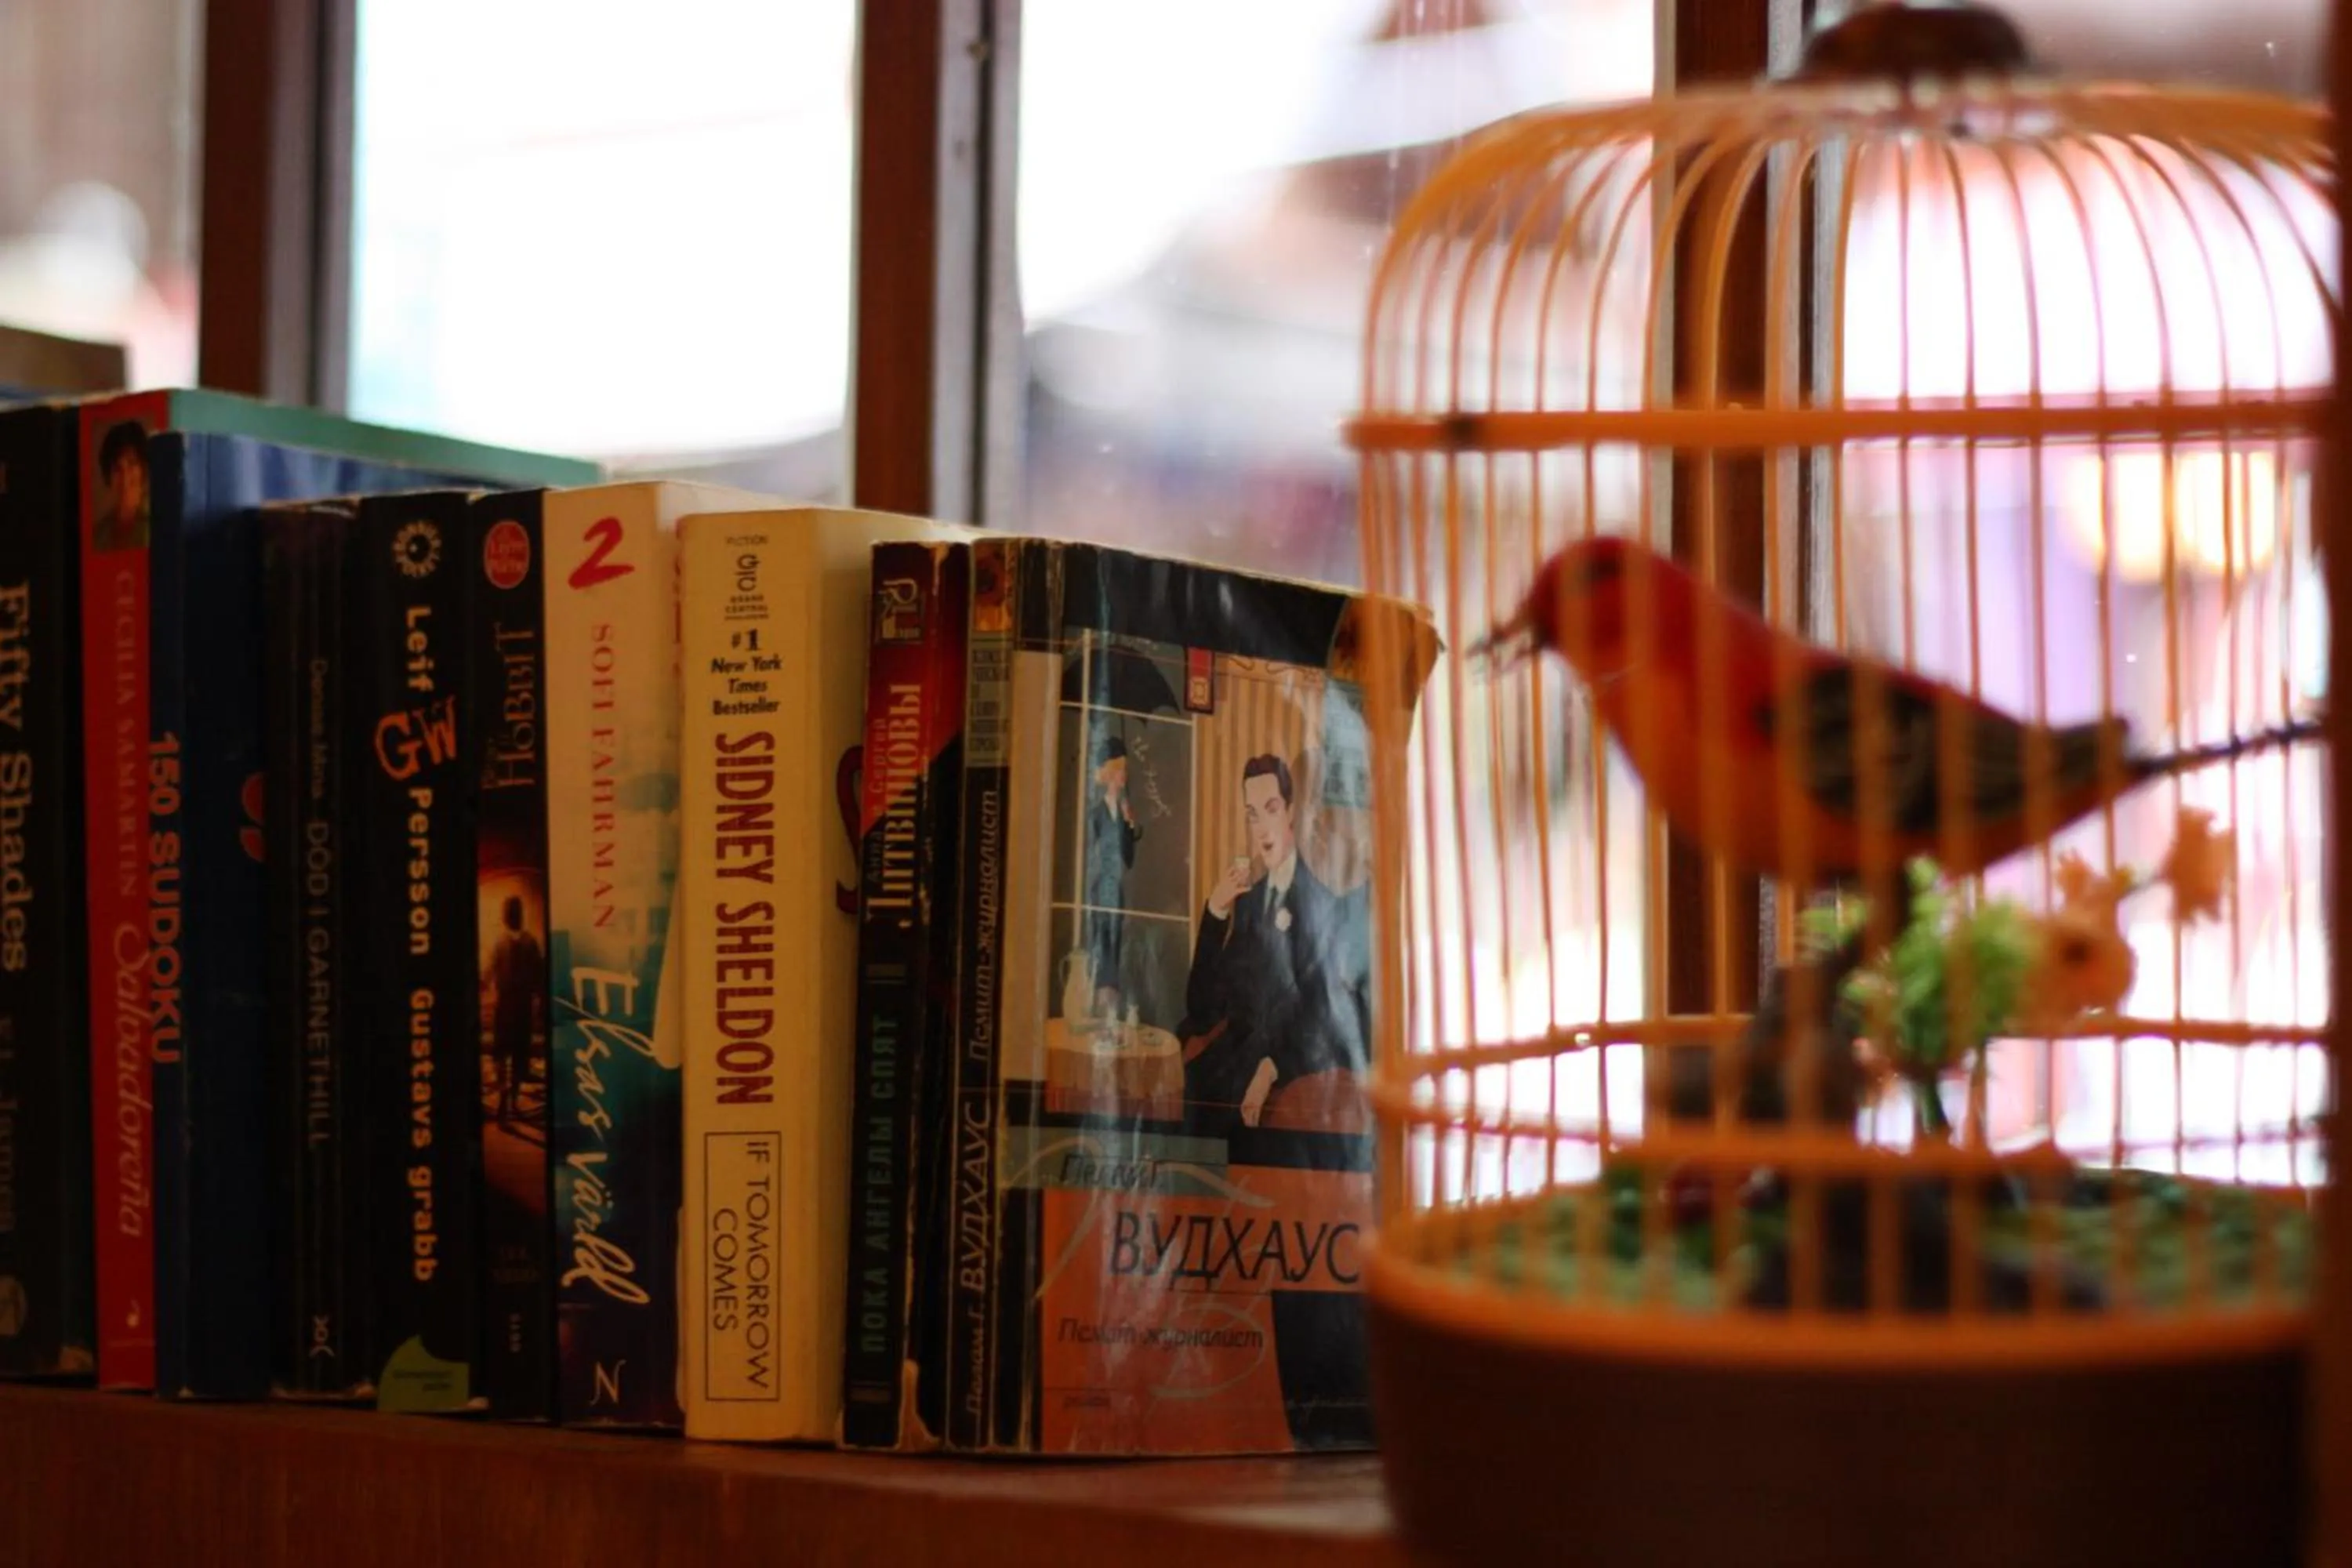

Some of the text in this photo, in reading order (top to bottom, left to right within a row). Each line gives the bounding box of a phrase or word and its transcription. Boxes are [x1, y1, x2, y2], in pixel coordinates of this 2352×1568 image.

[405, 603, 435, 693] Leif
[568, 516, 634, 590] 2
[710, 655, 782, 674] New York
[0, 579, 34, 971] Fifty Shades
[114, 569, 138, 895] CECILIA SAMARTIN
[592, 624, 614, 930] SOFI FAHRMAN
[712, 697, 780, 716] Bestseller
[728, 677, 767, 695] Times
[147, 731, 181, 1065] 150 SUDOKU
[306, 818, 333, 895] DOD
[408, 786, 436, 955] Persson
[716, 731, 775, 1104] SIDNEY SHELDON
[114, 919, 154, 1238] Salvadoreña
[306, 924, 332, 1150] GARNETHILL
[405, 987, 441, 1283] Gustavs grabb
[551, 967, 663, 1305] Elsas värld
[713, 1207, 739, 1331] COMES
[746, 1140, 771, 1391] IF TOMORROW
[859, 1012, 898, 1354] ПОКА АНГЕЛЫ СПЯТ
[959, 1101, 993, 1293] ВУДХАУС
[1107, 1210, 1360, 1294] ВУДХАУС
